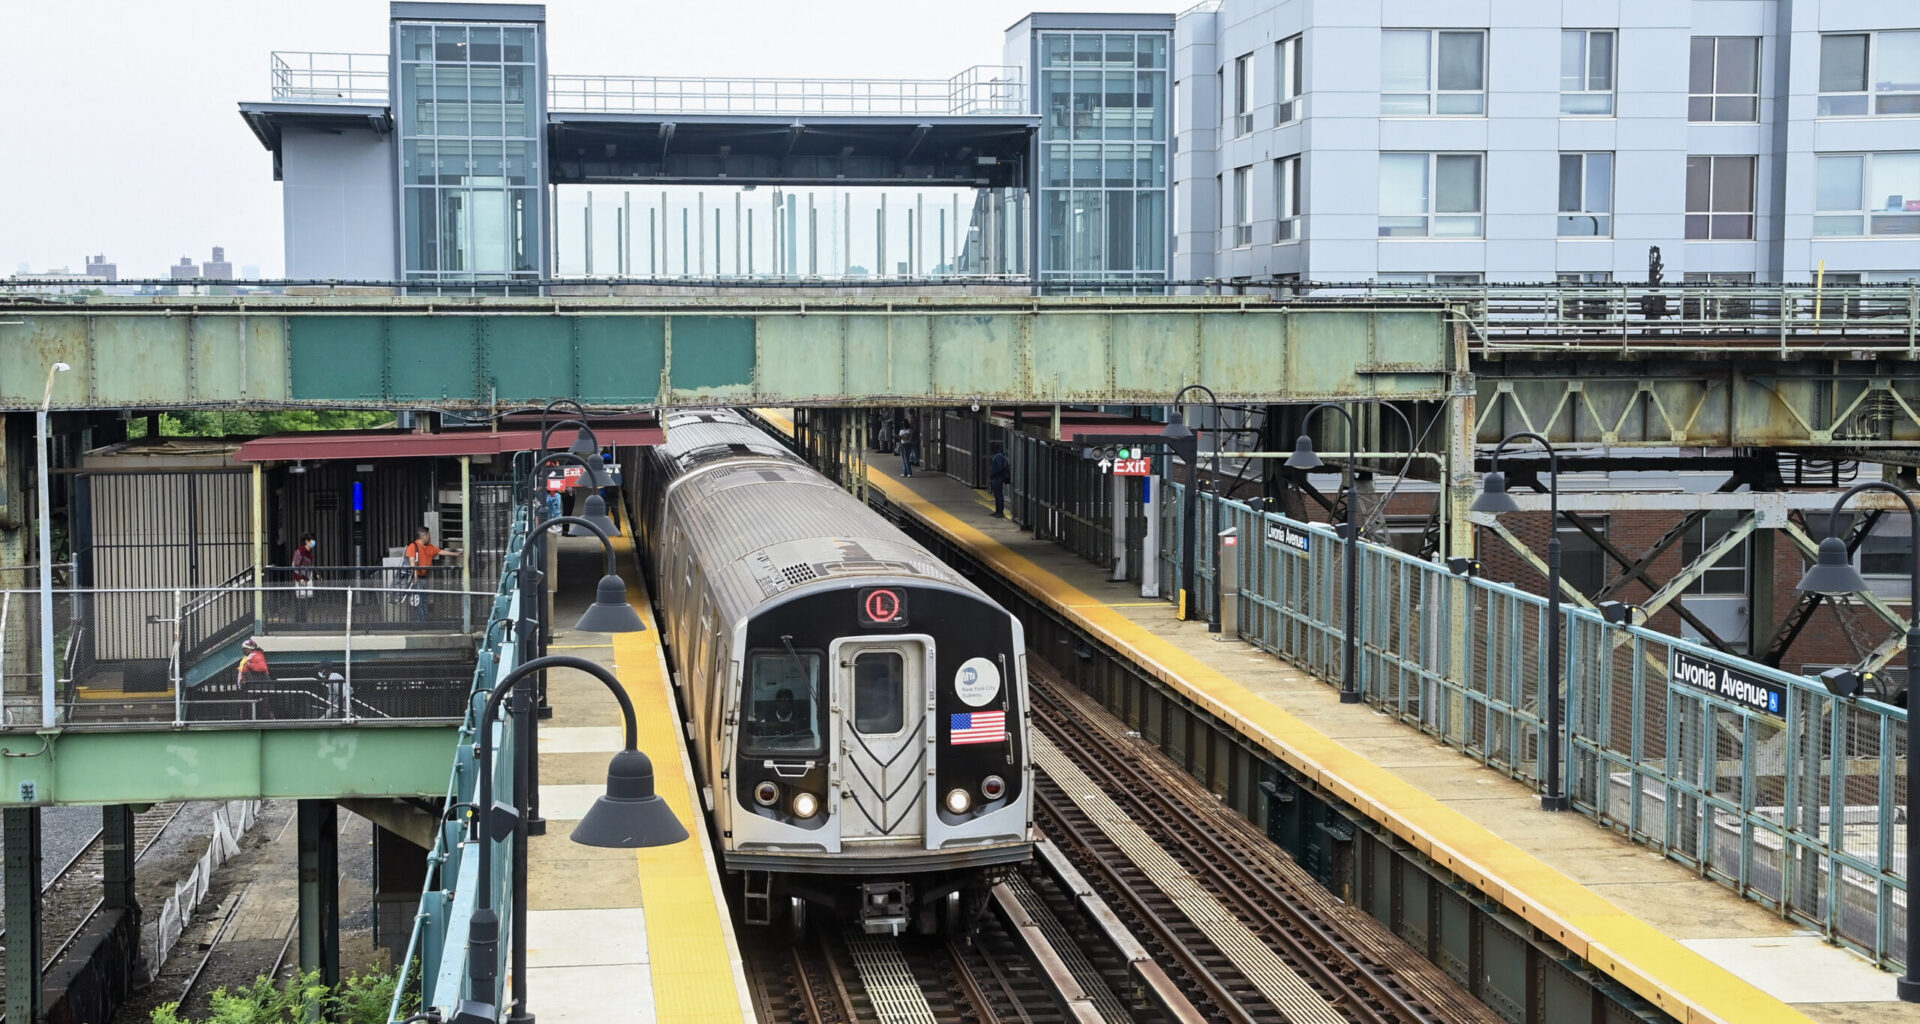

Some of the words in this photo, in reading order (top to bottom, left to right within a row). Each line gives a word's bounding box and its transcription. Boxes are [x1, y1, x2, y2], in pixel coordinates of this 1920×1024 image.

[564, 468, 582, 476] Exit
[1113, 458, 1146, 473] Exit
[1268, 521, 1285, 542] Livonia
[1286, 528, 1304, 549] Avenue
[876, 596, 889, 616] L
[962, 671, 976, 682] MTA
[1674, 653, 1716, 691] Livonia
[1720, 669, 1768, 708] Avenue
